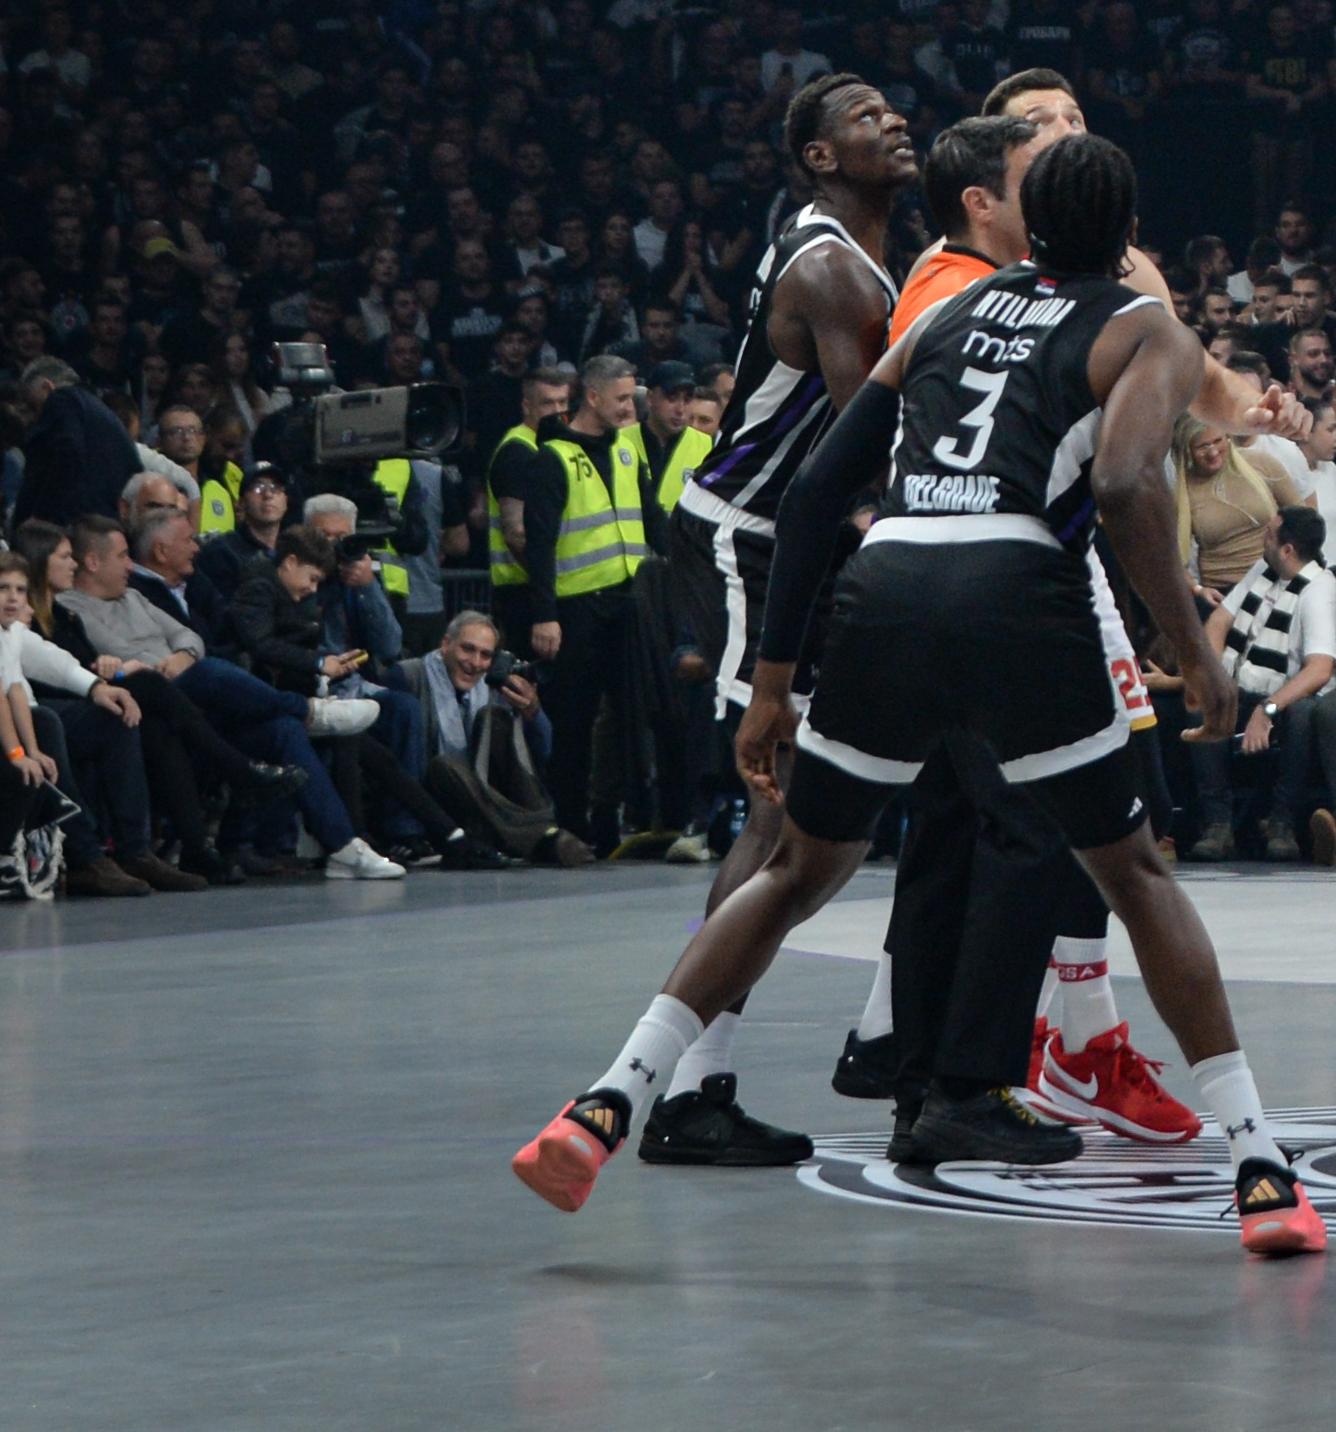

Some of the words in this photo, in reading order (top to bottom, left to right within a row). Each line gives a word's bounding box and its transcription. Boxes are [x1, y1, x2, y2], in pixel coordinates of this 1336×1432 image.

[961, 330, 1036, 363] mts
[933, 366, 1010, 470] 3
[904, 473, 1001, 513] BELGRADE
